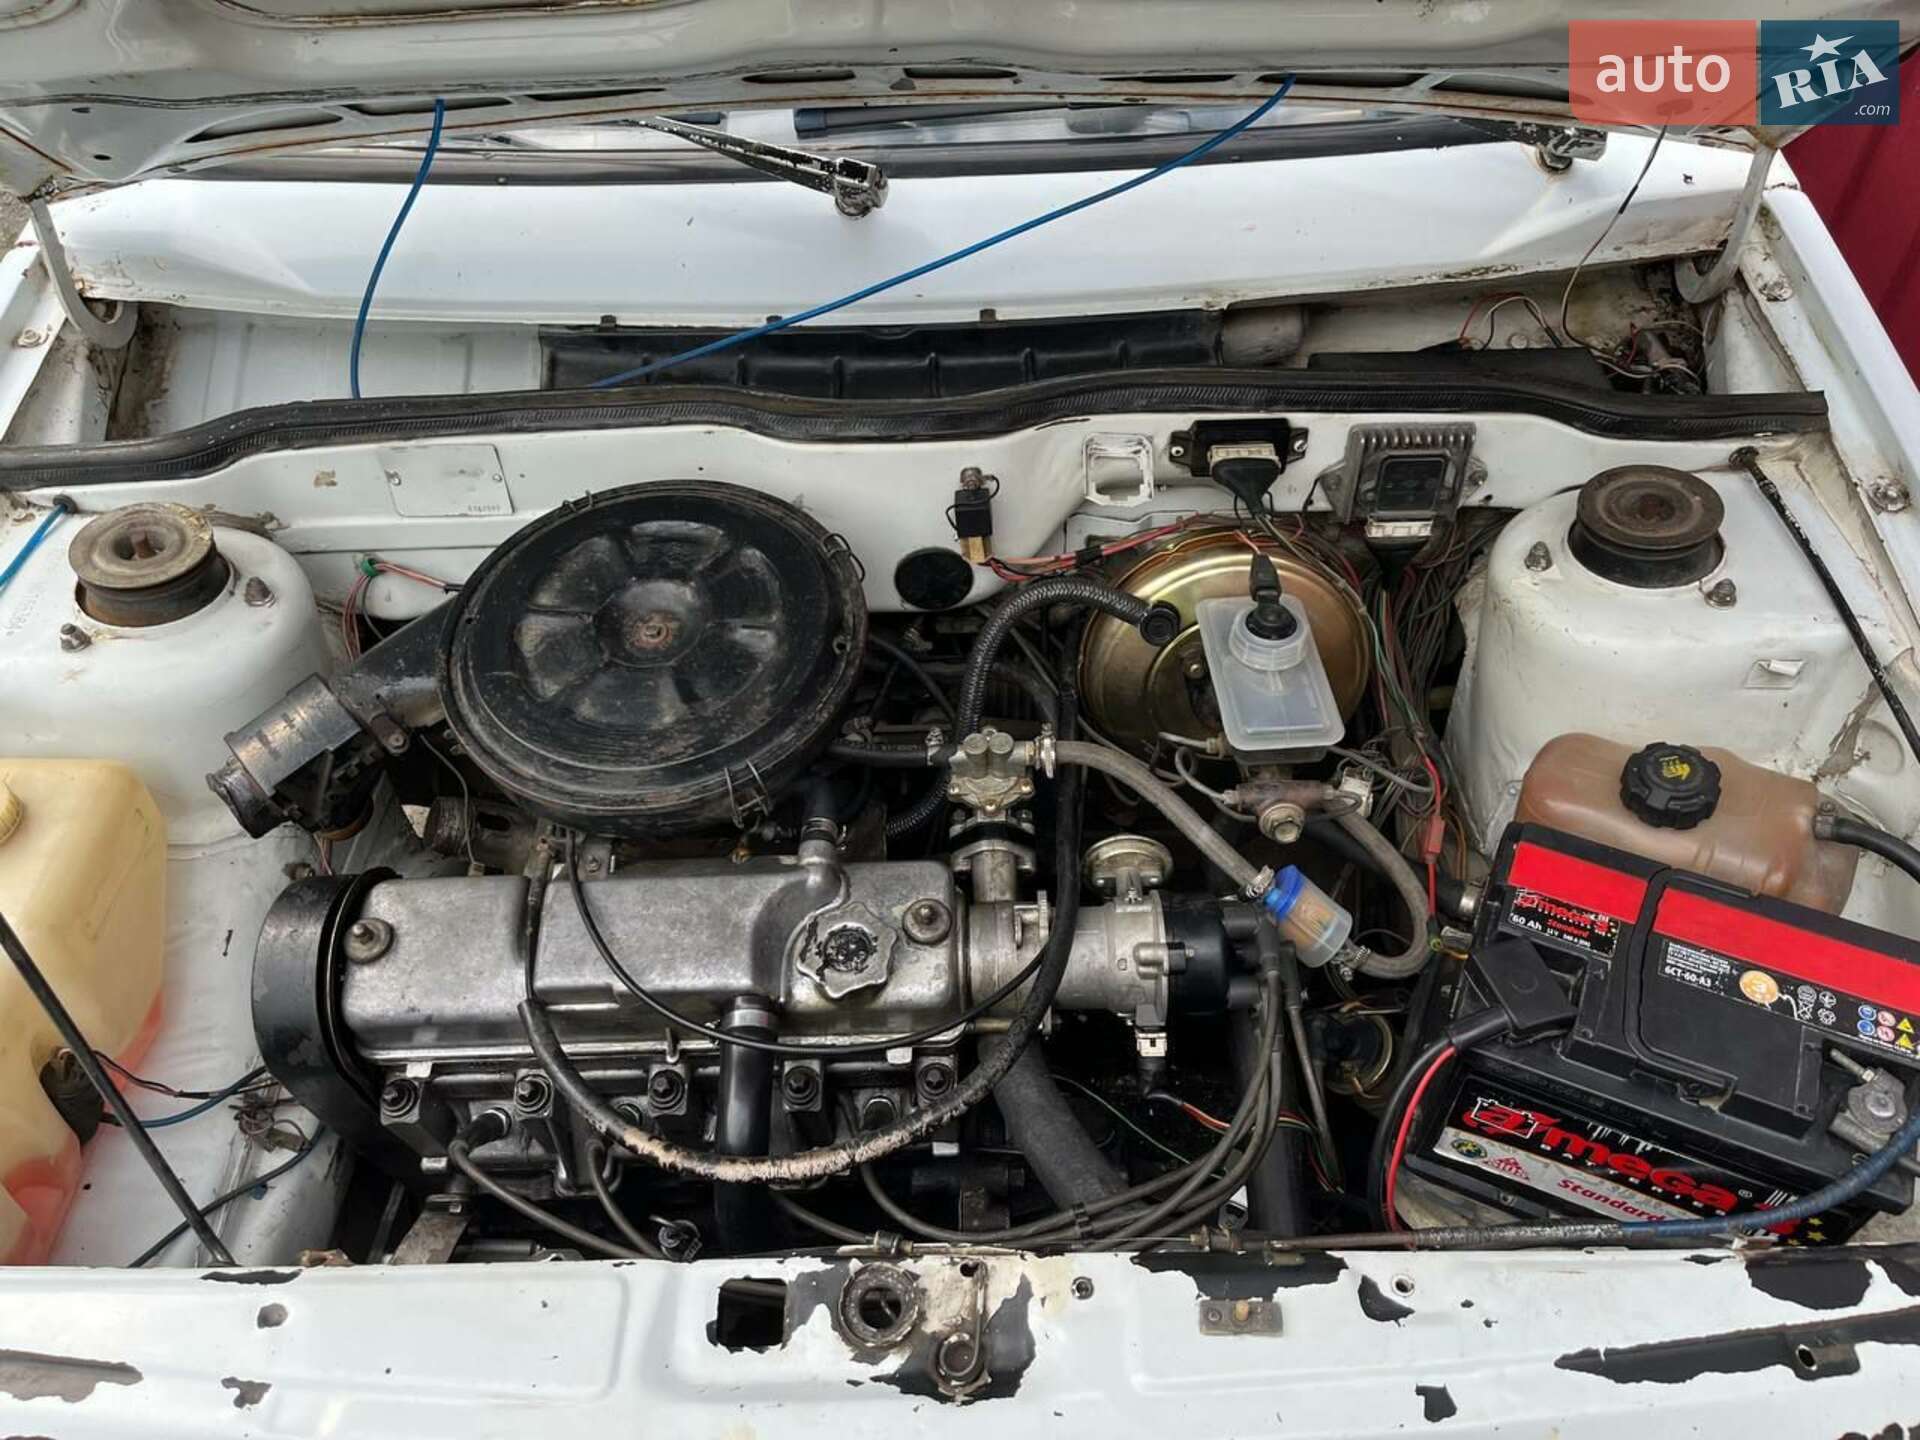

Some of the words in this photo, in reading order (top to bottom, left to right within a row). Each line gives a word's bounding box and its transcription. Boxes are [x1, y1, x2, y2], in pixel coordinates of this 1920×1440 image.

[1512, 914, 1526, 925] 60
[1527, 920, 1542, 931] Ah
[1557, 1178, 1668, 1222] Standard
